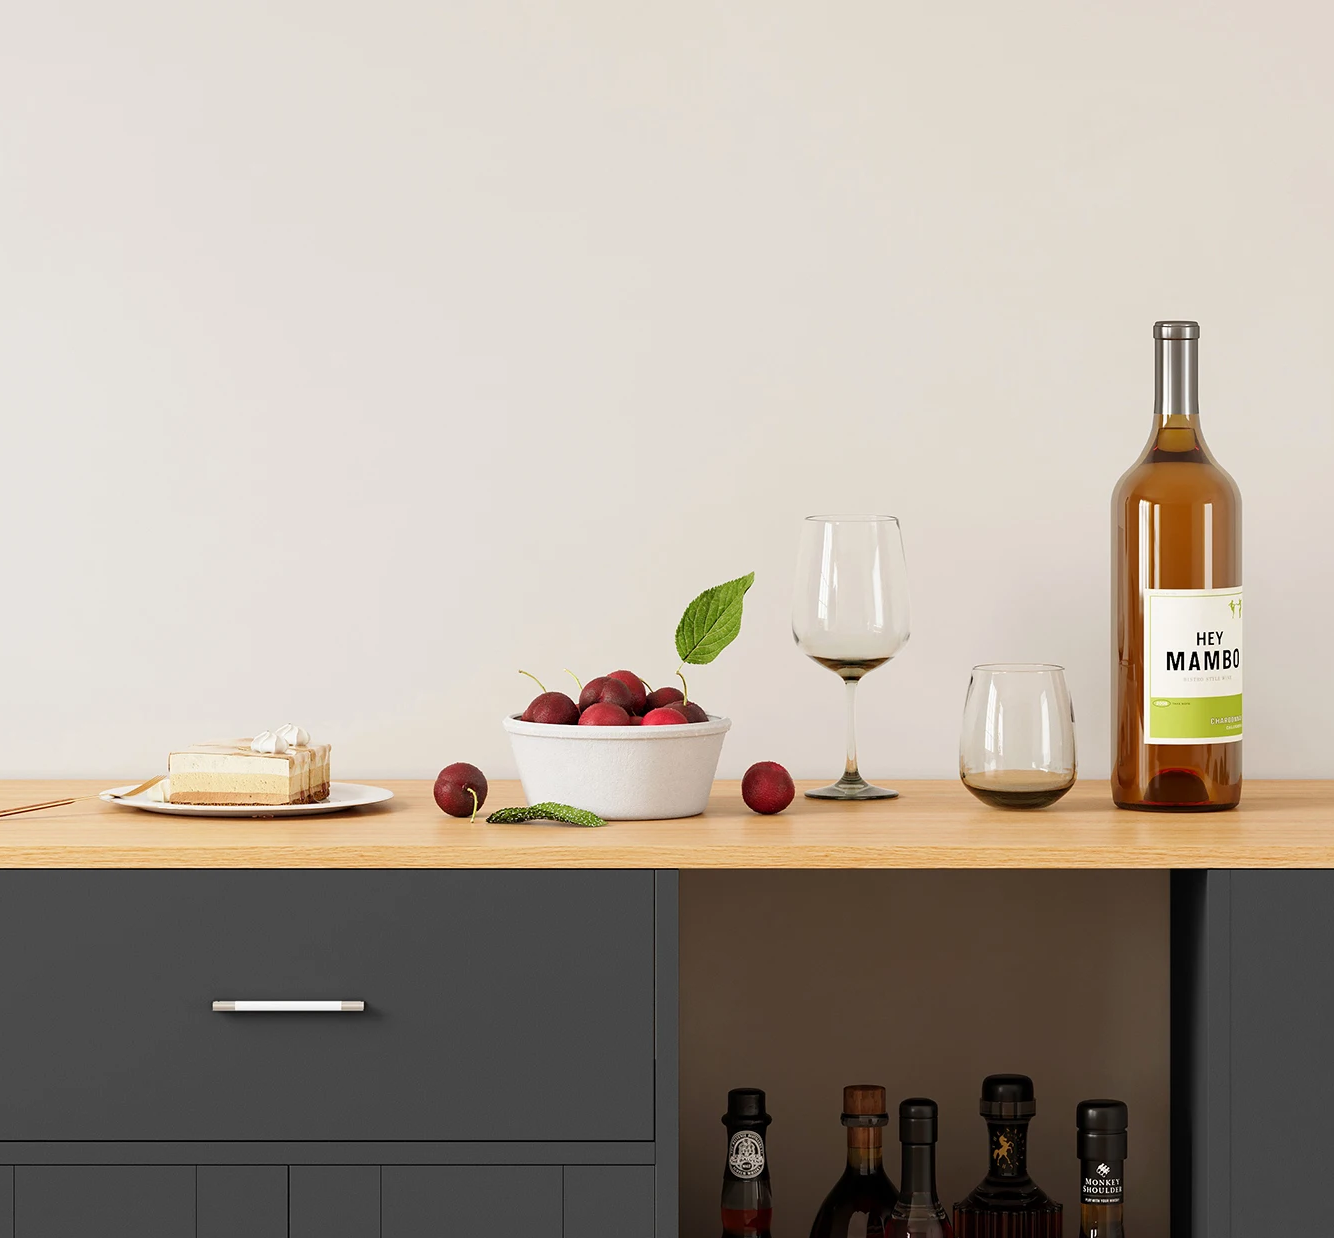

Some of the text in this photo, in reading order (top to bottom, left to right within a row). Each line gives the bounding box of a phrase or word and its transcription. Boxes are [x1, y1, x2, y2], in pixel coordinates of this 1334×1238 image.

[1196, 631, 1224, 646] HEY
[1165, 648, 1240, 671] MAMBO
[1085, 1177, 1120, 1186] MONKEY
[1082, 1185, 1122, 1194] SHOULDER
